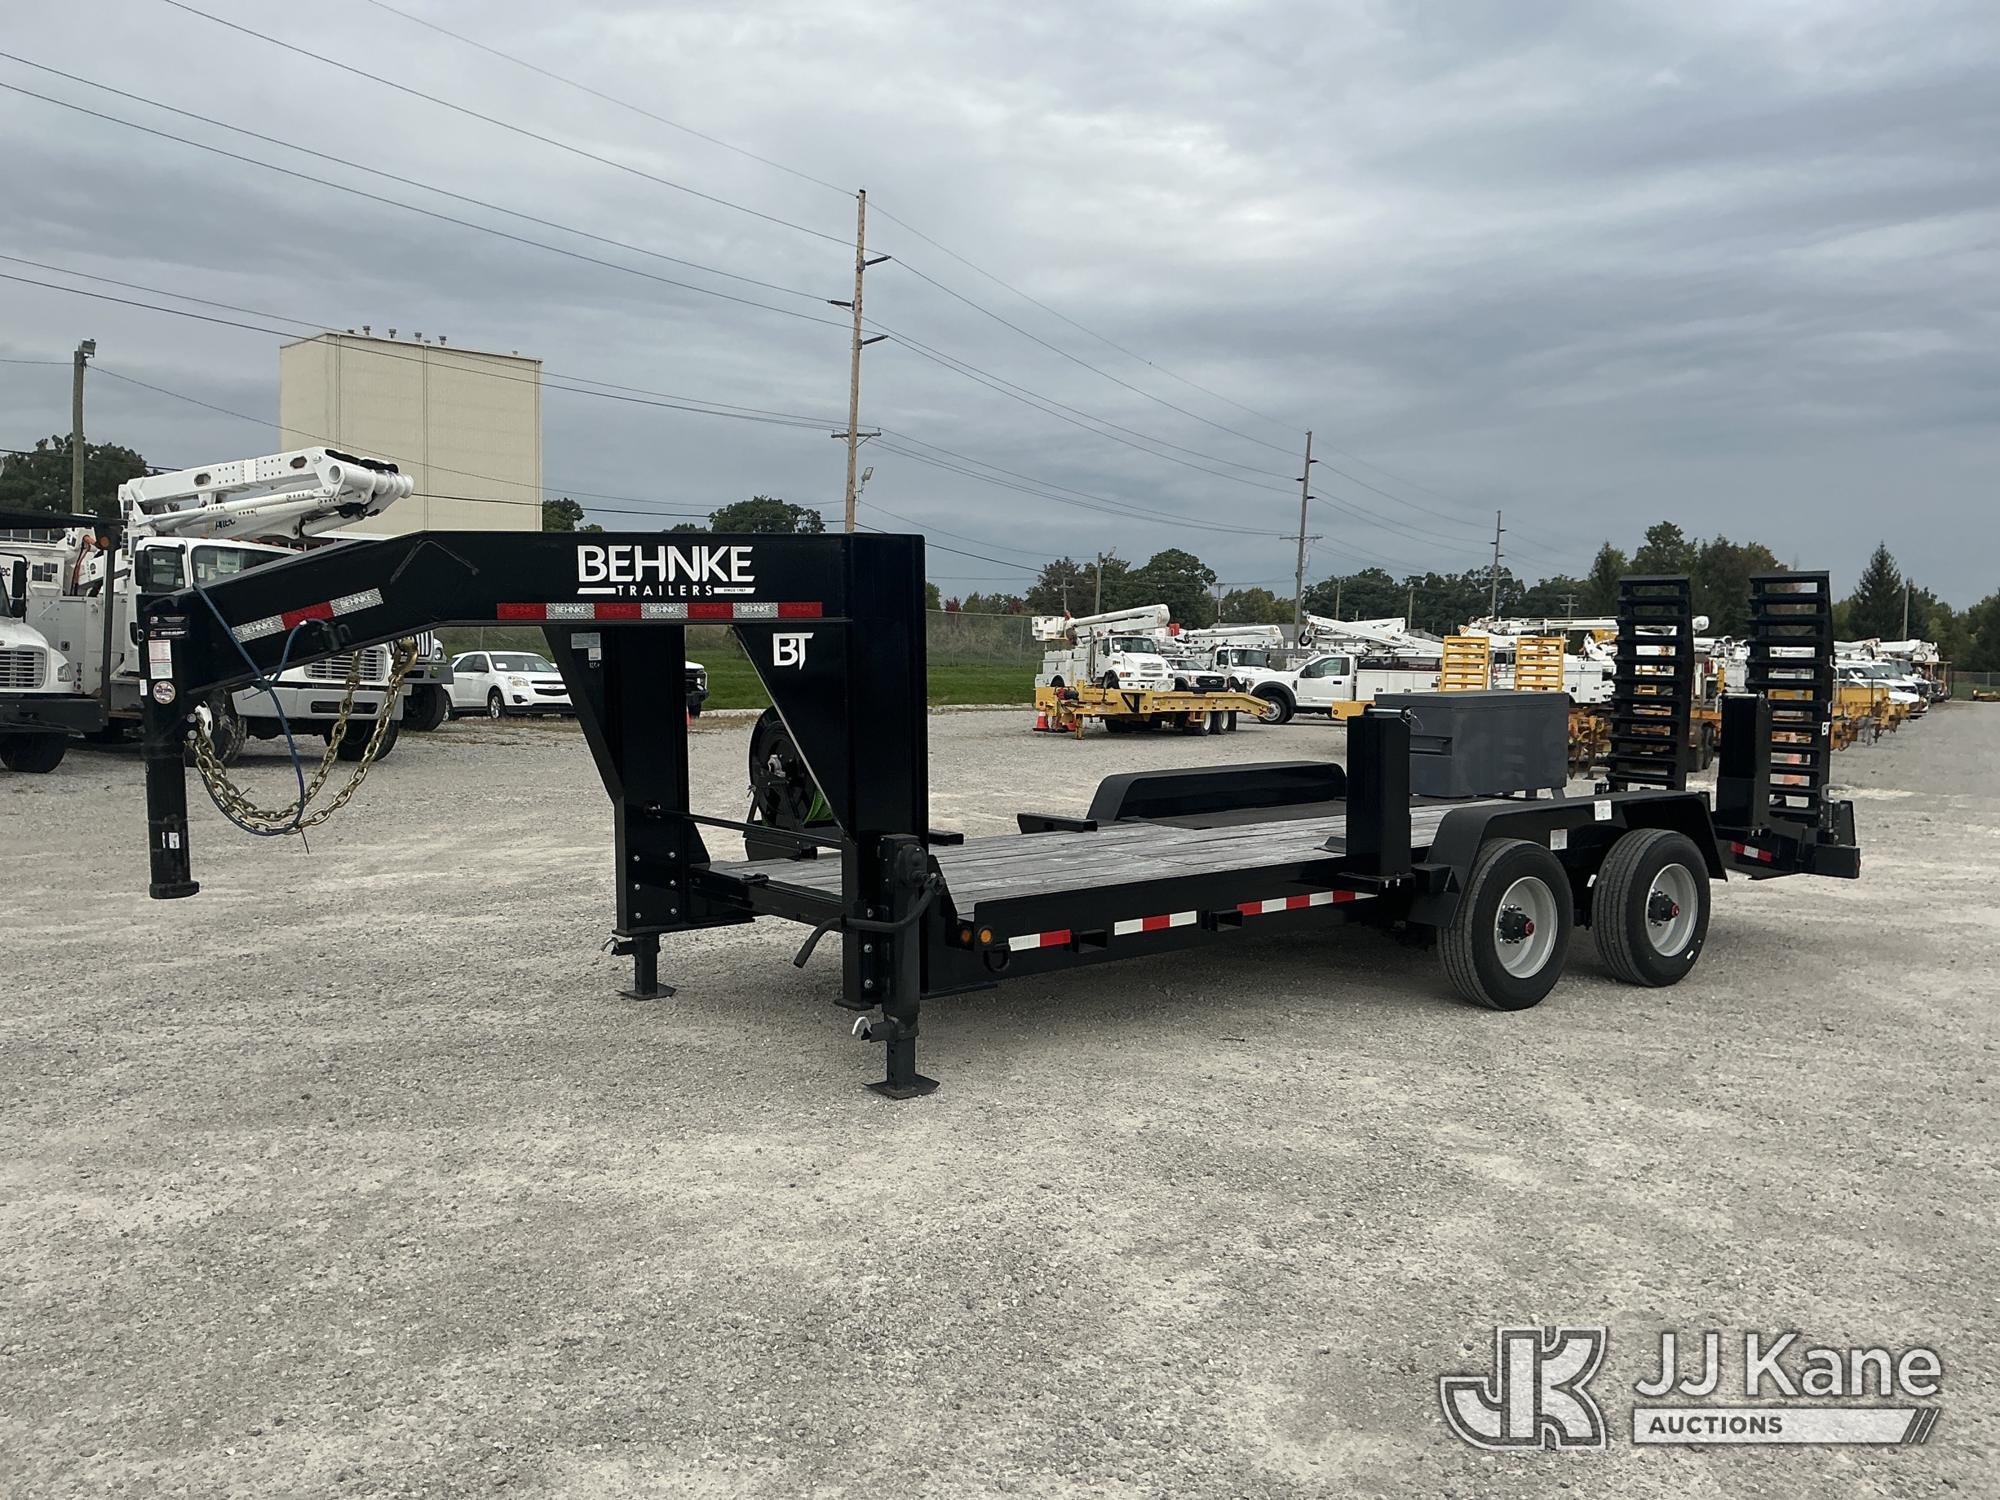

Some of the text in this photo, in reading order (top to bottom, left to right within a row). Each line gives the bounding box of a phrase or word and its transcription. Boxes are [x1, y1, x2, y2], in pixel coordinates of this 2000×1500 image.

[577, 545, 756, 582] BEHNKE
[555, 606, 586, 614] BEHNKE
[649, 605, 680, 614] BEHNKE
[741, 605, 771, 613] BEHNKE
[617, 585, 713, 597] TRAILERS
[241, 593, 372, 636] BEHNKE BEHNKE
[772, 632, 815, 670] BT
